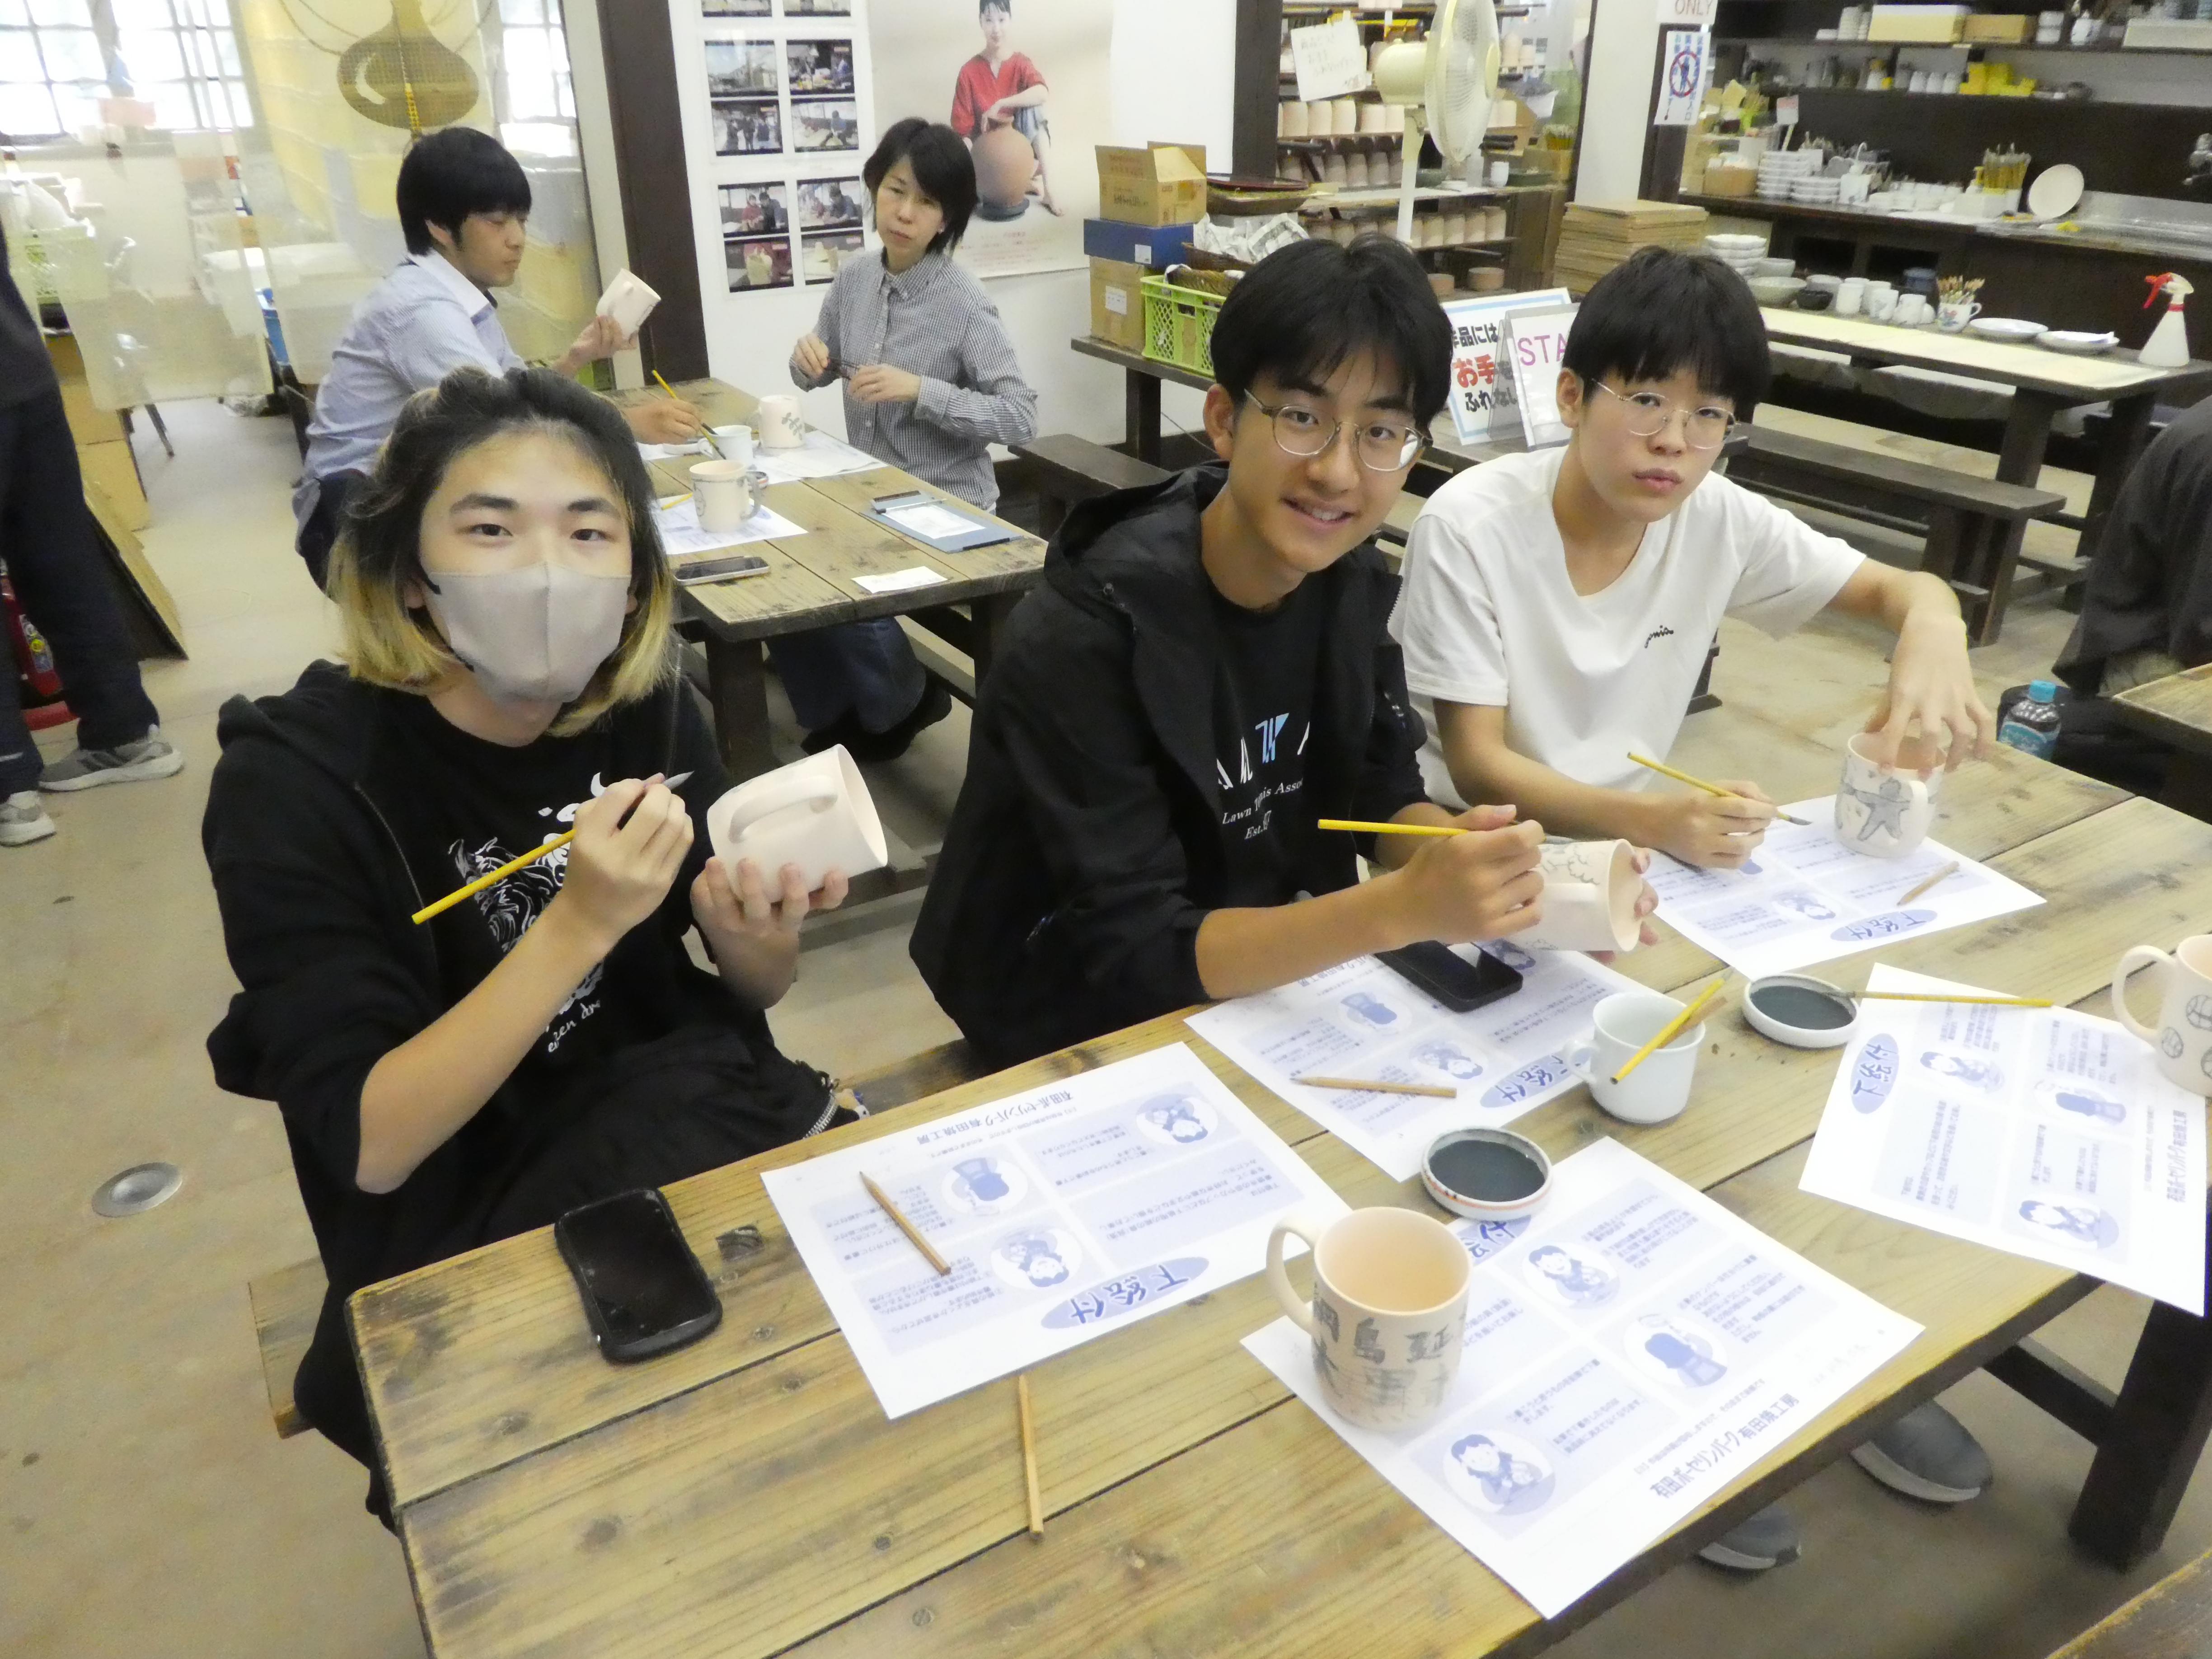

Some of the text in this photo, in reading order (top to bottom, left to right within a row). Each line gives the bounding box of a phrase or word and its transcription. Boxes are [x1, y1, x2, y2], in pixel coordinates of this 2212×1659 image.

[1223, 808, 1251, 824] Lawn
[1853, 1044, 1898, 1096] 下絵付
[1071, 1264, 1190, 1324] 下絵付
[1736, 1392, 1801, 1441] 有田焼工房
